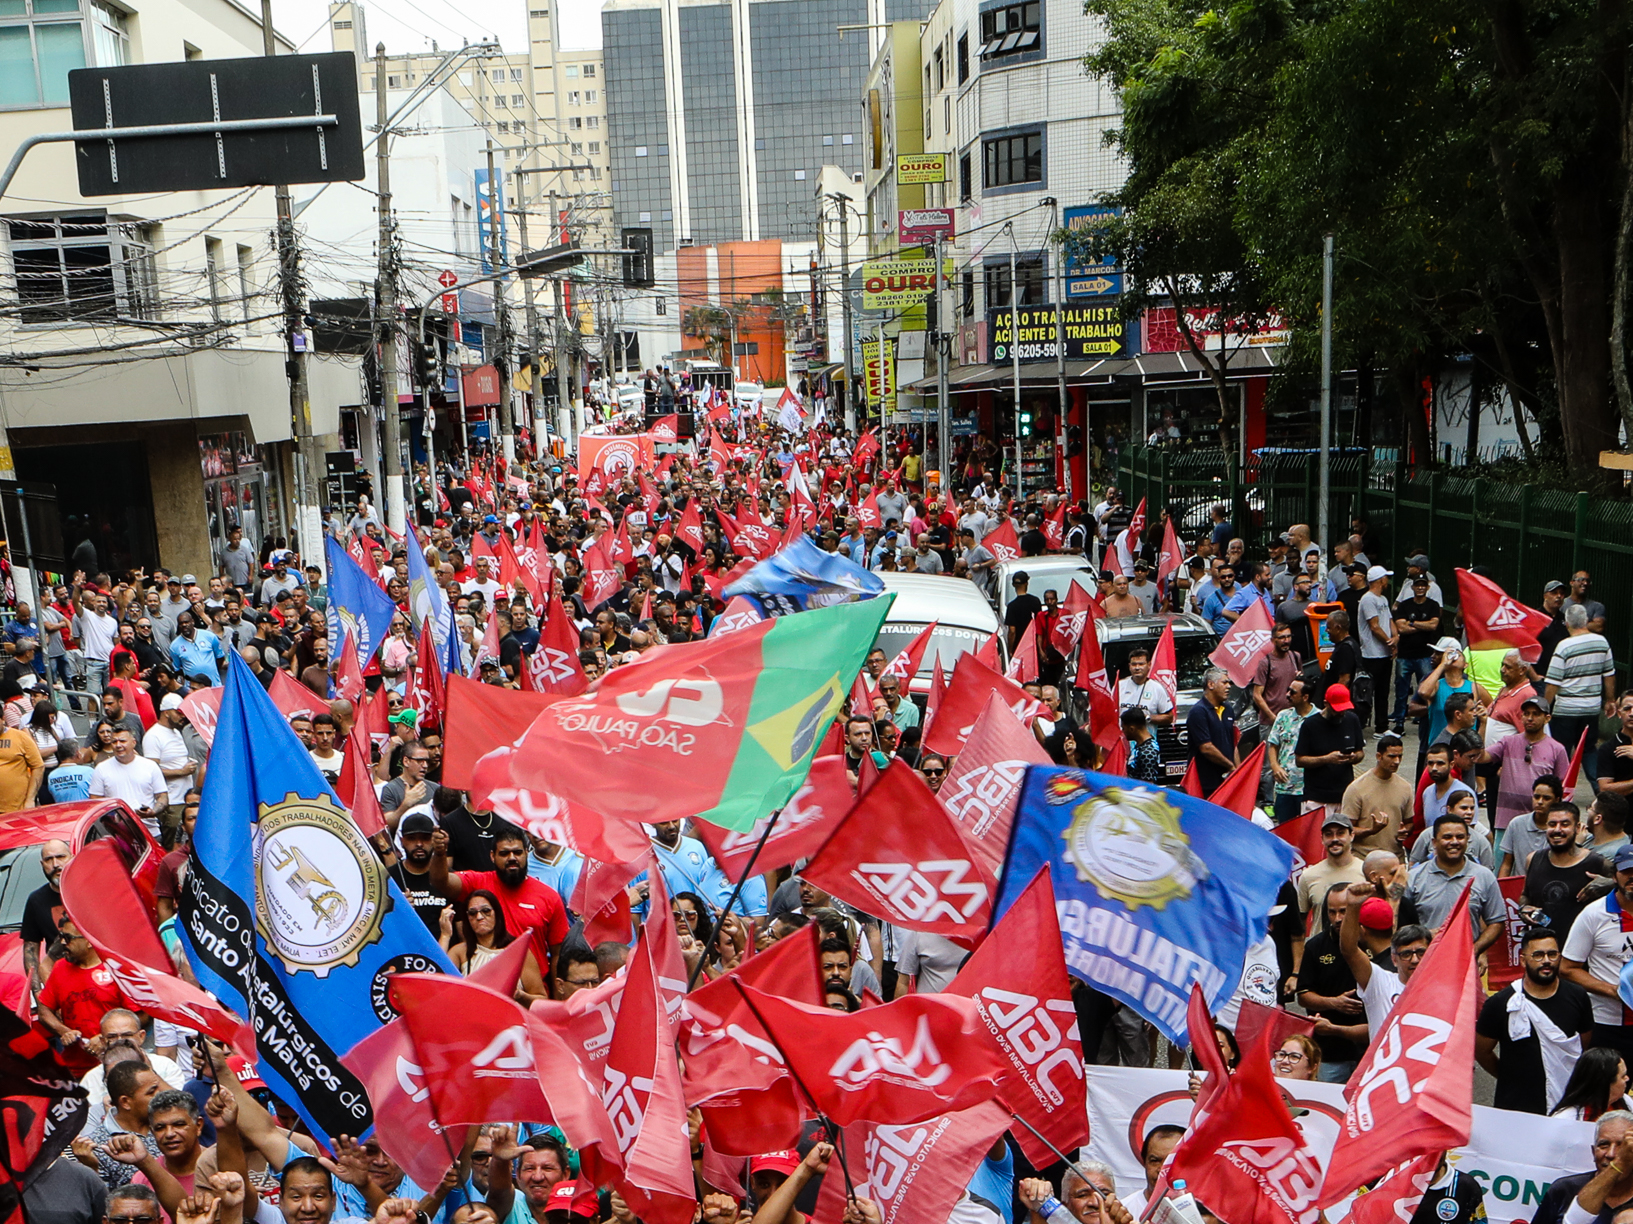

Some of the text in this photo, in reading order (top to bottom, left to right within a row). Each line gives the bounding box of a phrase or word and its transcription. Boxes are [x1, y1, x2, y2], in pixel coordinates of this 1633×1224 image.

[900, 162, 942, 171] OURO
[880, 268, 935, 276] COMPRO
[866, 274, 949, 294] OURO
[1073, 281, 1107, 291] SALA 01
[995, 310, 1029, 330] AÇÃO
[995, 327, 1046, 343] ACIENTE
[1066, 323, 1122, 339] TRABALHO
[1085, 343, 1102, 352] SALA
[1103, 343, 1112, 351] 01
[865, 352, 892, 360] COMRO
[604, 443, 636, 456] QUÍMICOS
[954, 631, 970, 639] DO
[49, 774, 83, 786] SINDICATO
[263, 819, 281, 834] DOS
[281, 812, 354, 841] TRABALHADORES
[352, 839, 367, 860] NAS
[413, 895, 447, 907] AVIÕES
[96, 972, 111, 982] 13
[186, 855, 240, 933] ndicato
[339, 1090, 367, 1120] de
[189, 909, 239, 968] Santo
[261, 1024, 313, 1092] Mauá
[971, 993, 1000, 1036] SINDICATO
[555, 1186, 575, 1197] CU
